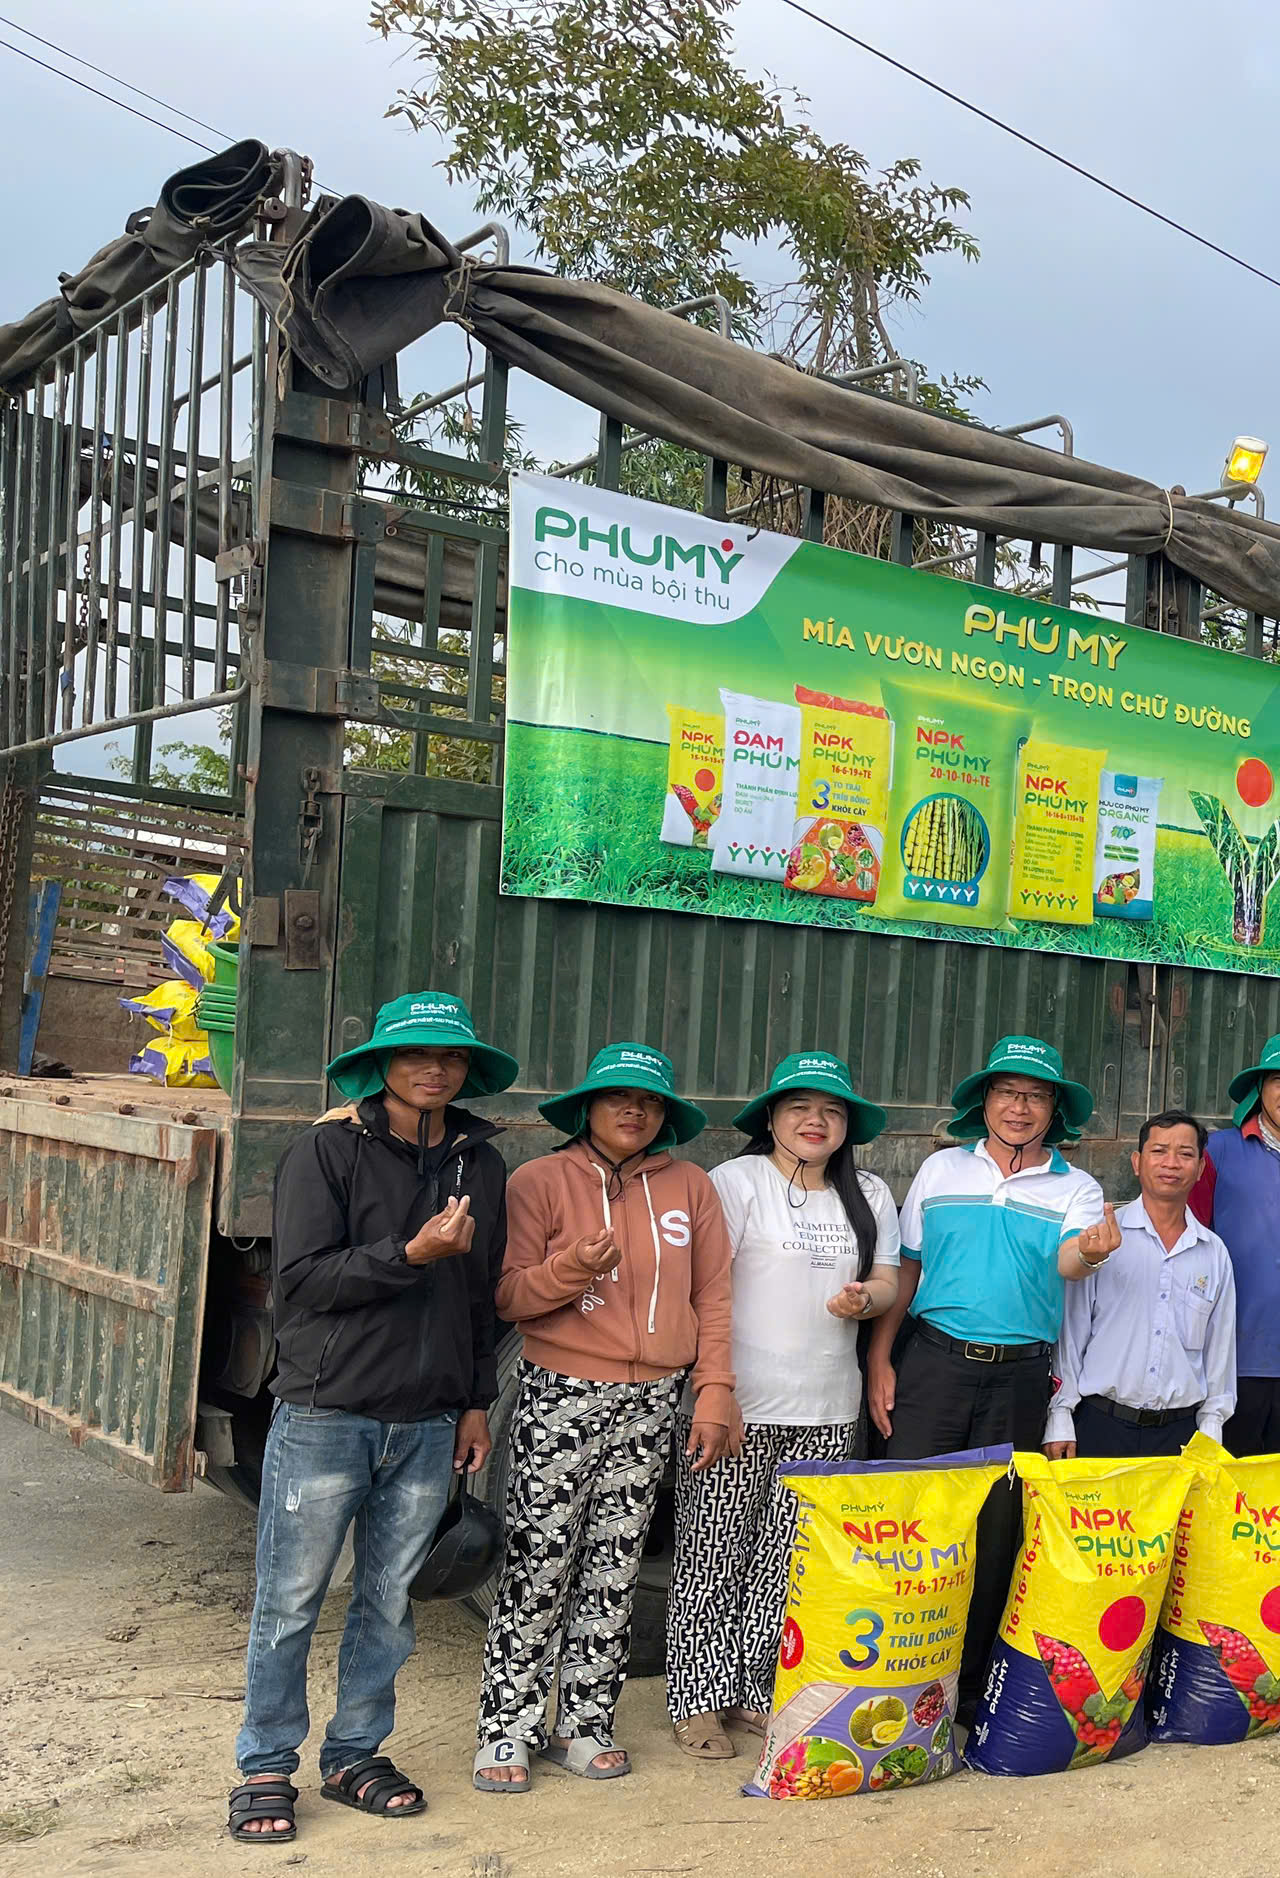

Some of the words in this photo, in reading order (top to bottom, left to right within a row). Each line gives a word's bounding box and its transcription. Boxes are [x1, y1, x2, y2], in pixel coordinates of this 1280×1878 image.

[534, 551, 584, 577] Cho
[593, 566, 643, 591] mùa
[652, 575, 687, 602] bội
[695, 587, 730, 610] thu
[963, 603, 1061, 654] PHÚ
[1067, 627, 1128, 670] MỸ
[802, 616, 855, 652] MÍA
[864, 631, 942, 672] VƯƠN
[951, 651, 1026, 690] NGỌN
[1049, 674, 1114, 710] TRỌN
[1120, 690, 1168, 721] CHỮ
[1174, 703, 1252, 739] ĐƯỜNG
[681, 729, 715, 745] NPK
[732, 730, 784, 752] ĐẠM
[813, 731, 854, 751] NPK
[916, 727, 965, 751] NPK
[690, 754, 725, 765] 15-15-15+T
[711, 745, 725, 757] M
[733, 748, 782, 768] PHÚ
[786, 756, 800, 772] M
[812, 748, 850, 763] PHÚ
[916, 747, 961, 767] PHÚ
[930, 766, 991, 788] 20-10-10+TE
[1025, 774, 1068, 795] NPK
[812, 778, 831, 810] 3
[1024, 792, 1062, 809] PHÚ
[1098, 807, 1150, 824] ORGANIC
[660, 1209, 691, 1247] S
[799, 1231, 849, 1243] EDITION
[782, 1241, 858, 1256] COLLECTIBL
[1070, 1506, 1136, 1533] NPK
[842, 1519, 928, 1545] NPK
[1168, 1508, 1194, 1627] 16-16-16+TE
[895, 1569, 967, 1596] 17-6-17+TE
[892, 1612, 915, 1625] TO
[920, 1606, 948, 1623] TRÁI
[839, 1608, 885, 1671] 3
[889, 1634, 925, 1648] TRĨU
[885, 1654, 927, 1672] KHỎE
[931, 1647, 953, 1665] CÂY
[983, 1659, 1000, 1701] NPK
[494, 1742, 515, 1762] G
